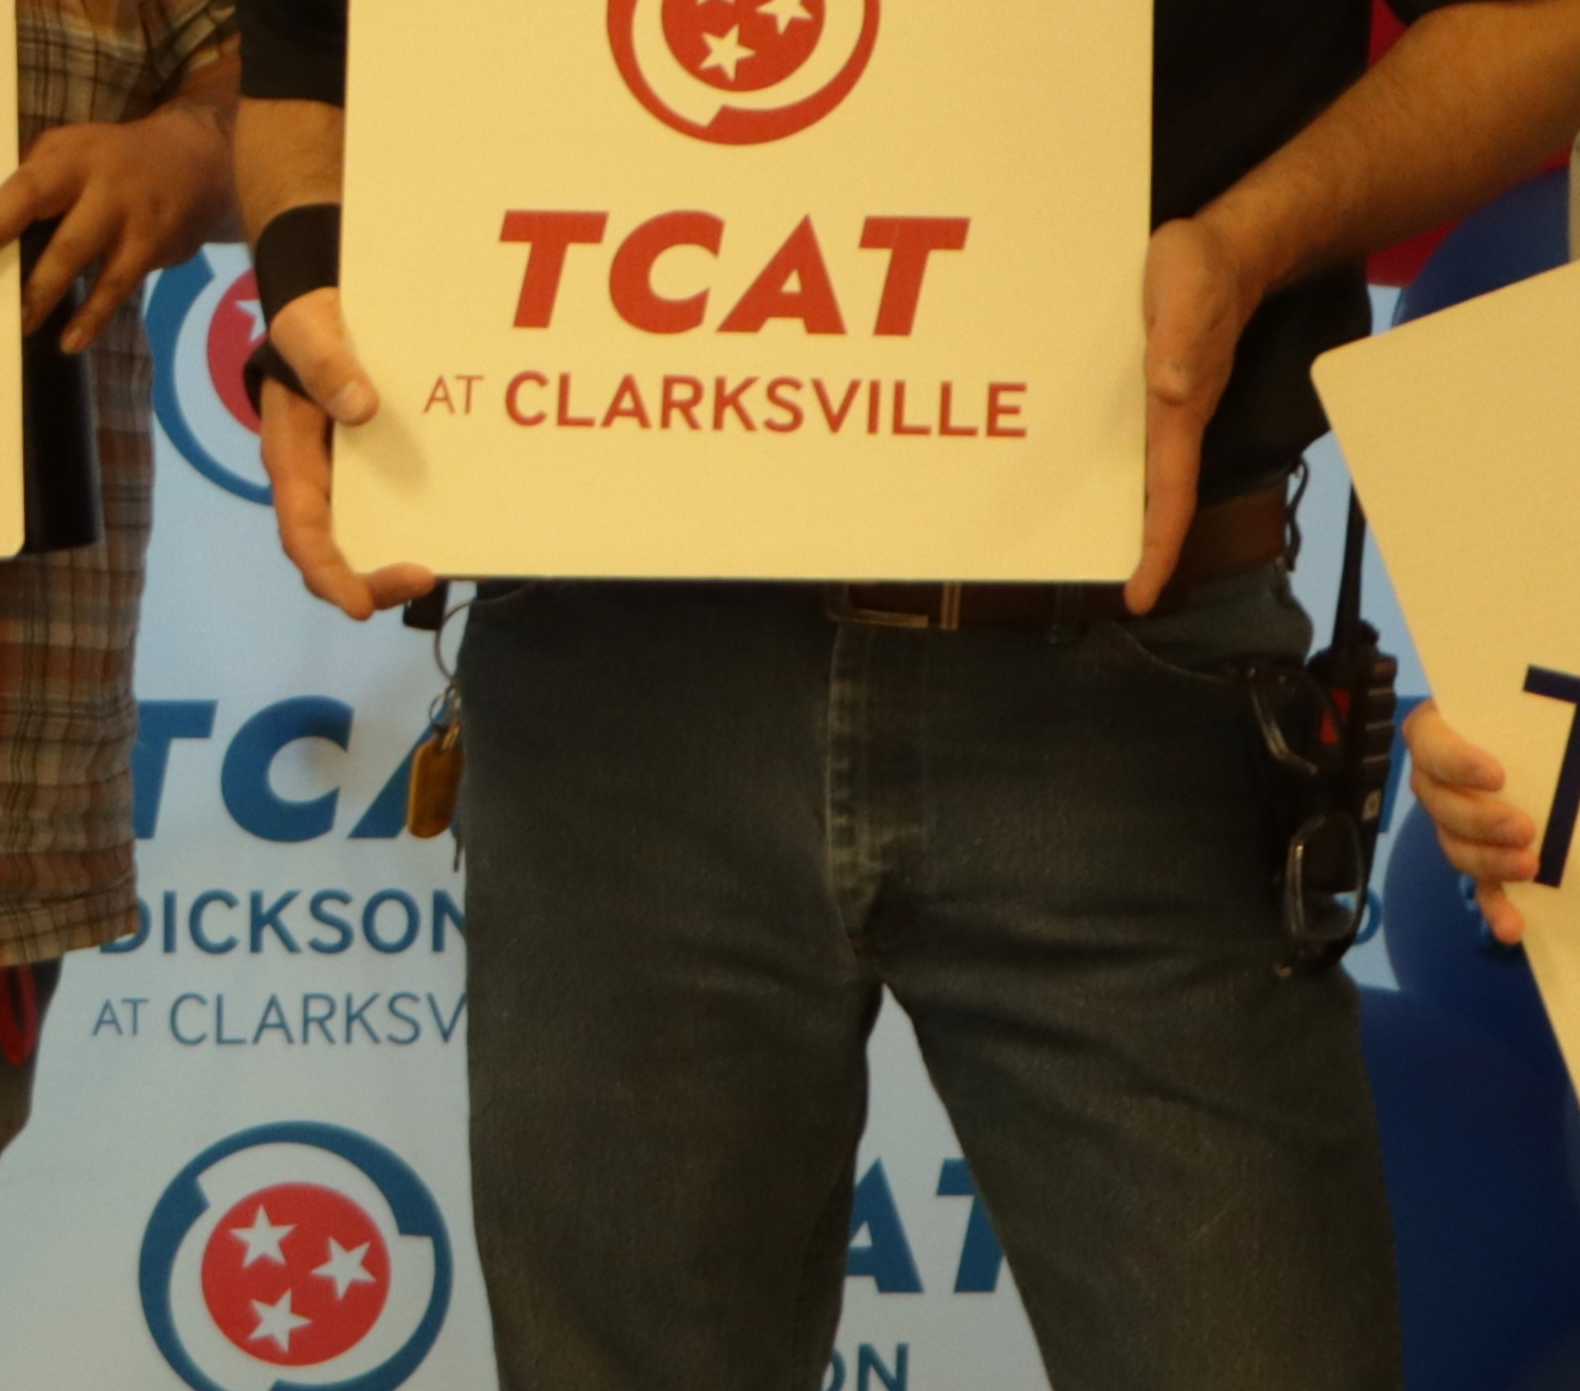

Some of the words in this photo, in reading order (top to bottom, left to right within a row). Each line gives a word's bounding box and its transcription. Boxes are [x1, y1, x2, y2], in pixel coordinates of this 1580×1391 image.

[498, 208, 972, 338] TCAT
[422, 374, 486, 415] AT
[504, 369, 1028, 439] CLARKSVILLE
[91, 997, 149, 1038] AT
[168, 991, 468, 1047] CLARKSV
